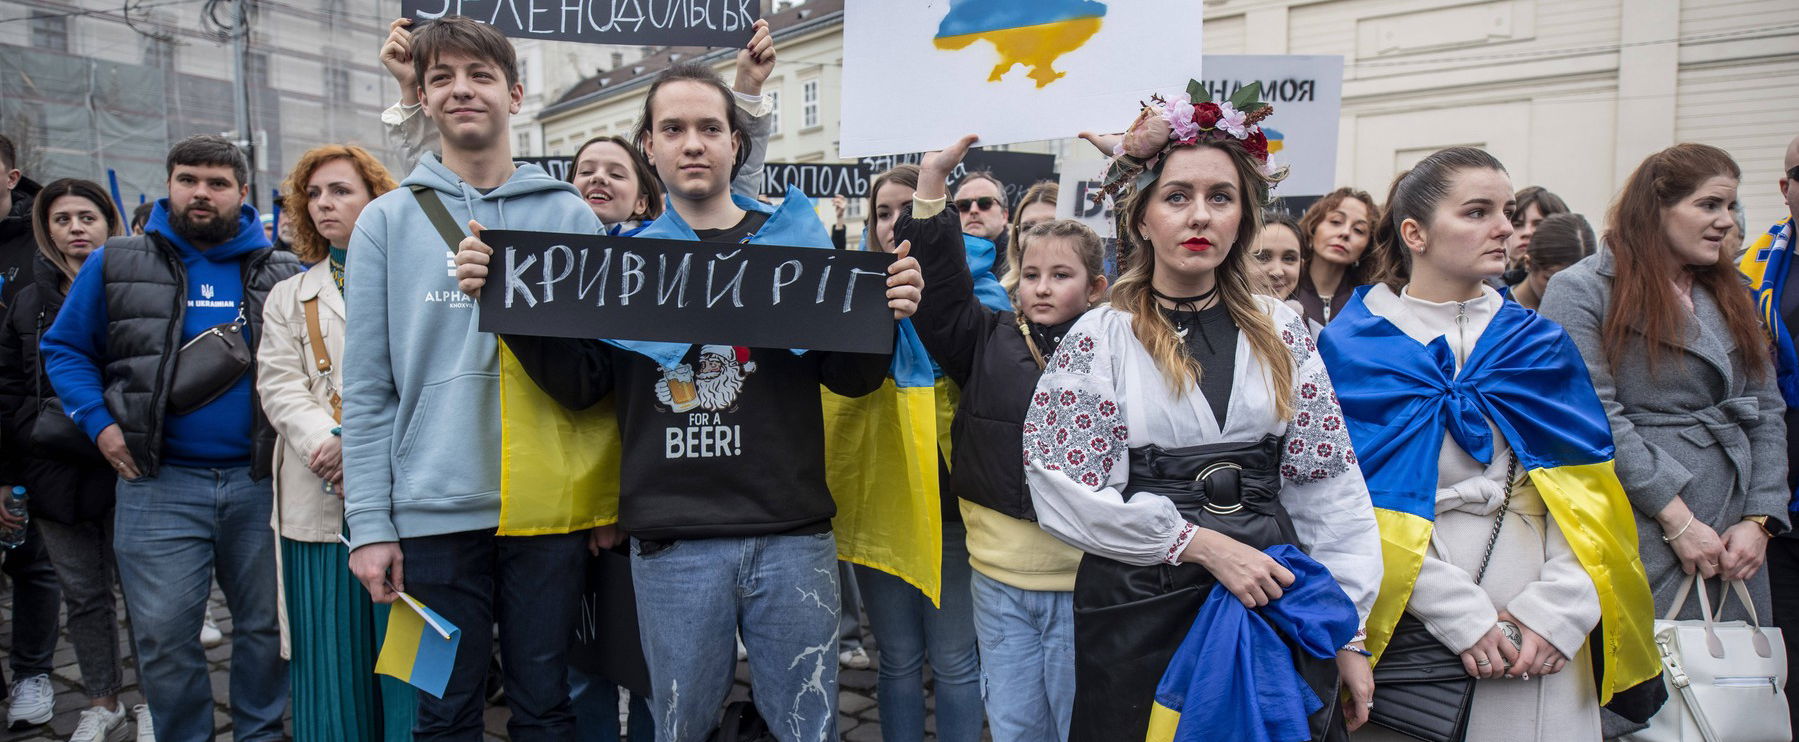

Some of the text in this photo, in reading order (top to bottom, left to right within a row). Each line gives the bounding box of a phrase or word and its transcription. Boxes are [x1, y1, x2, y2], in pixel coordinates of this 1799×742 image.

[504, 244, 749, 308] КРИВИЙ
[689, 412, 721, 426] FOR A
[665, 424, 742, 459] BEER!
